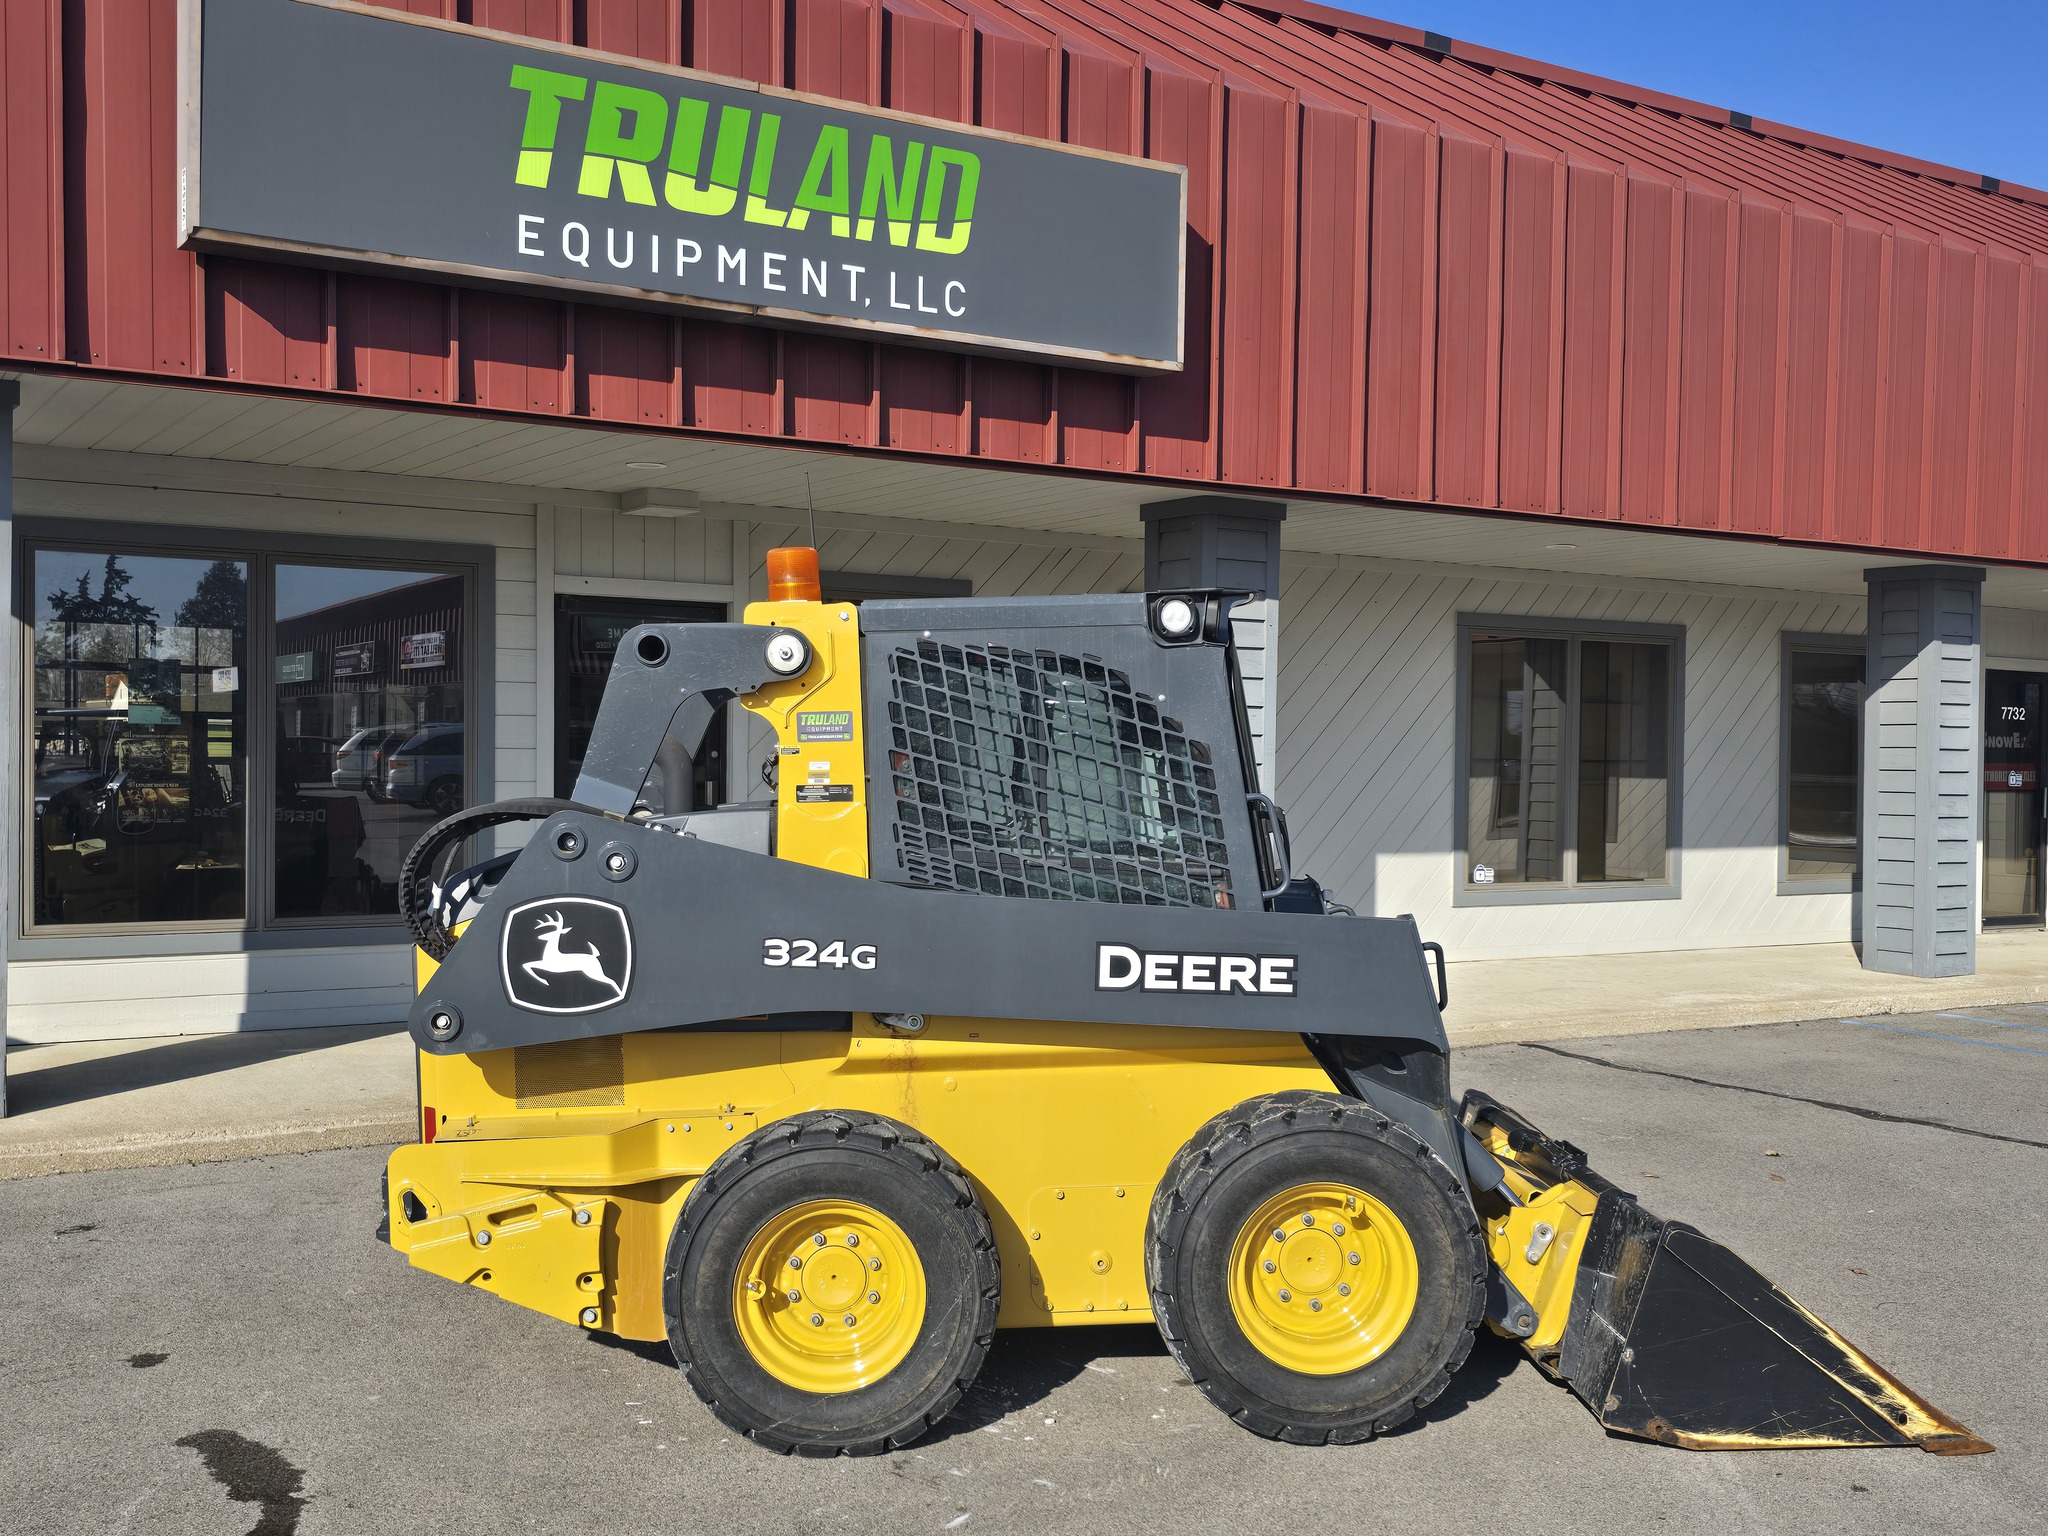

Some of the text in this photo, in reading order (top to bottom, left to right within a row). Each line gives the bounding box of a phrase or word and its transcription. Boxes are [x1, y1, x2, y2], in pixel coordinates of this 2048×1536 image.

[509, 63, 982, 256] TRULAND
[518, 213, 967, 318] EQUIPMENT, LLC
[800, 713, 850, 726] TRULAND
[2001, 706, 2026, 721] 7732
[763, 938, 877, 971] 324G
[1099, 945, 1295, 993] DEERE
